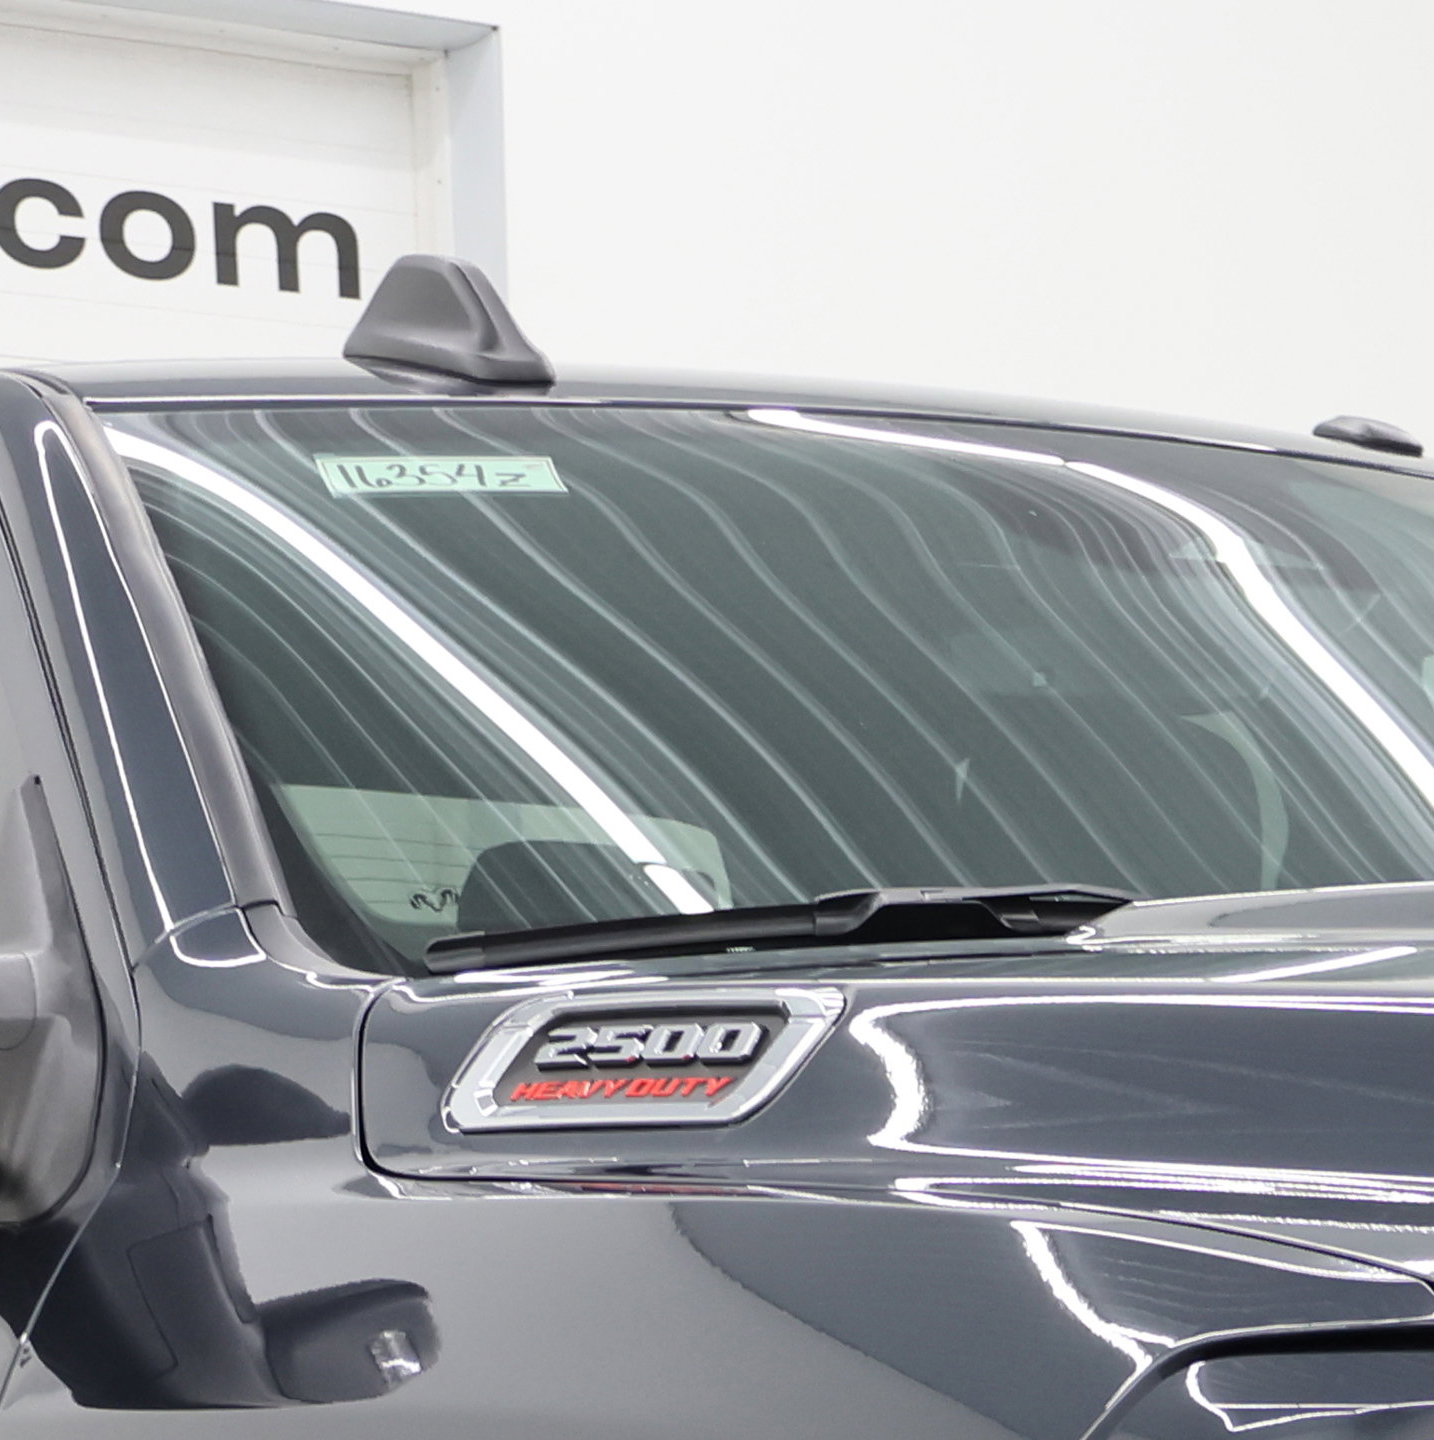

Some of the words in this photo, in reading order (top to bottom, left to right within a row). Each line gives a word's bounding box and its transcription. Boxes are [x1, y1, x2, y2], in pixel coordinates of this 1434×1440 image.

[534, 1020, 766, 1071] 2500
[510, 1077, 628, 1101] HEAVY
[625, 1077, 734, 1097] DUTY
